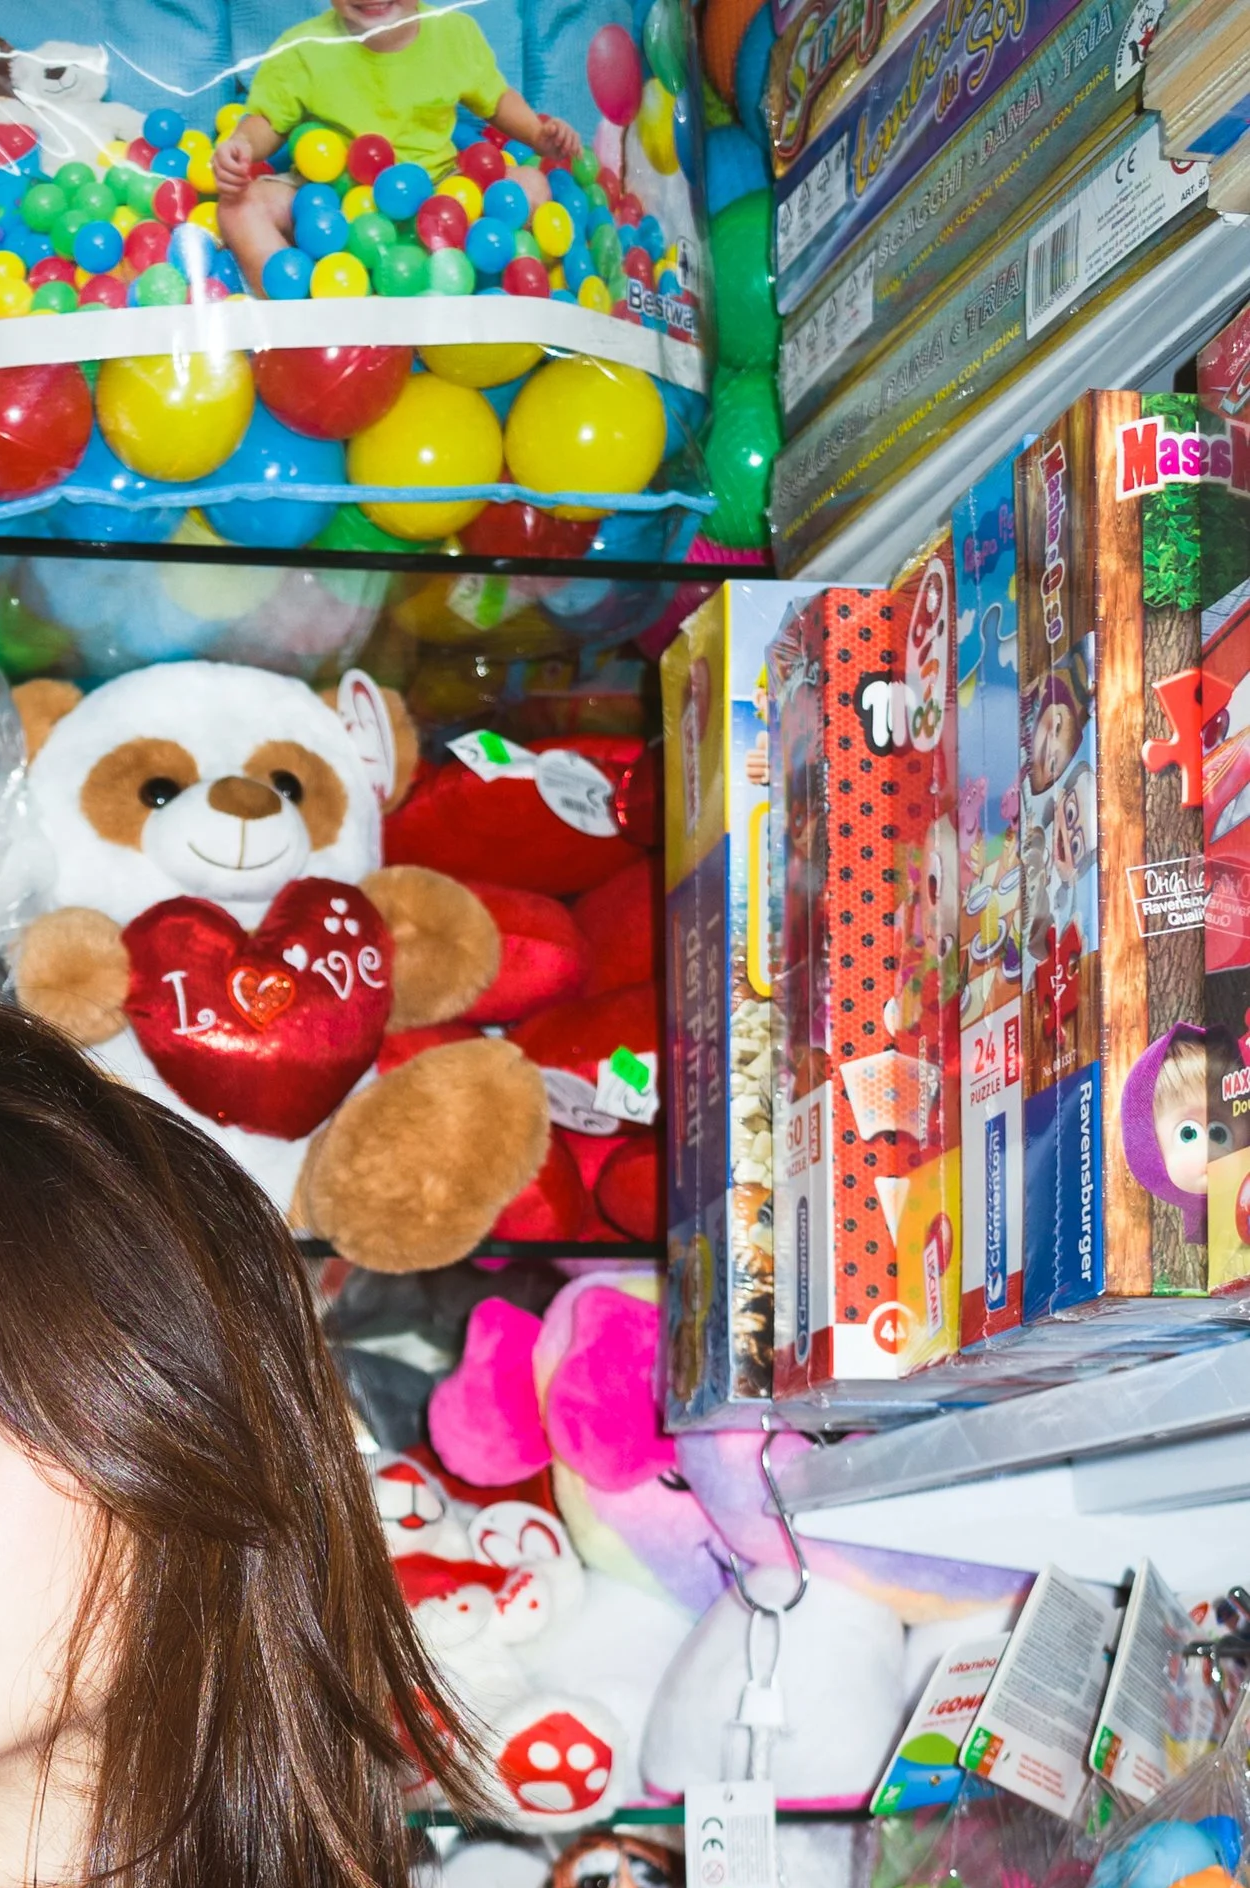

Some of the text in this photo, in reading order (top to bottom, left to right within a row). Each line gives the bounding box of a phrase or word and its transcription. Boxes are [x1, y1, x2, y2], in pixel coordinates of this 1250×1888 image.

[878, 5, 1114, 267] SCACCHI DAMA TRIA
[1030, 129, 1050, 158] TRIA
[1052, 106, 1072, 130] CON
[1074, 64, 1111, 109] PEDINE
[628, 280, 698, 338] Bestwa
[965, 260, 1022, 338] TRIA
[958, 359, 981, 386] CON
[982, 322, 1022, 368] PEDINE
[1040, 443, 1066, 547] Masha
[1042, 564, 1065, 642] Orso
[970, 1077, 1001, 1107] PUZZLE
[974, 1029, 996, 1074] 24
[1006, 1023, 1016, 1078] MAXI
[989, 1129, 1001, 1268] Clementoni
[1079, 1080, 1094, 1283] Ravensburger
[799, 1206, 808, 1326] Clementoni
